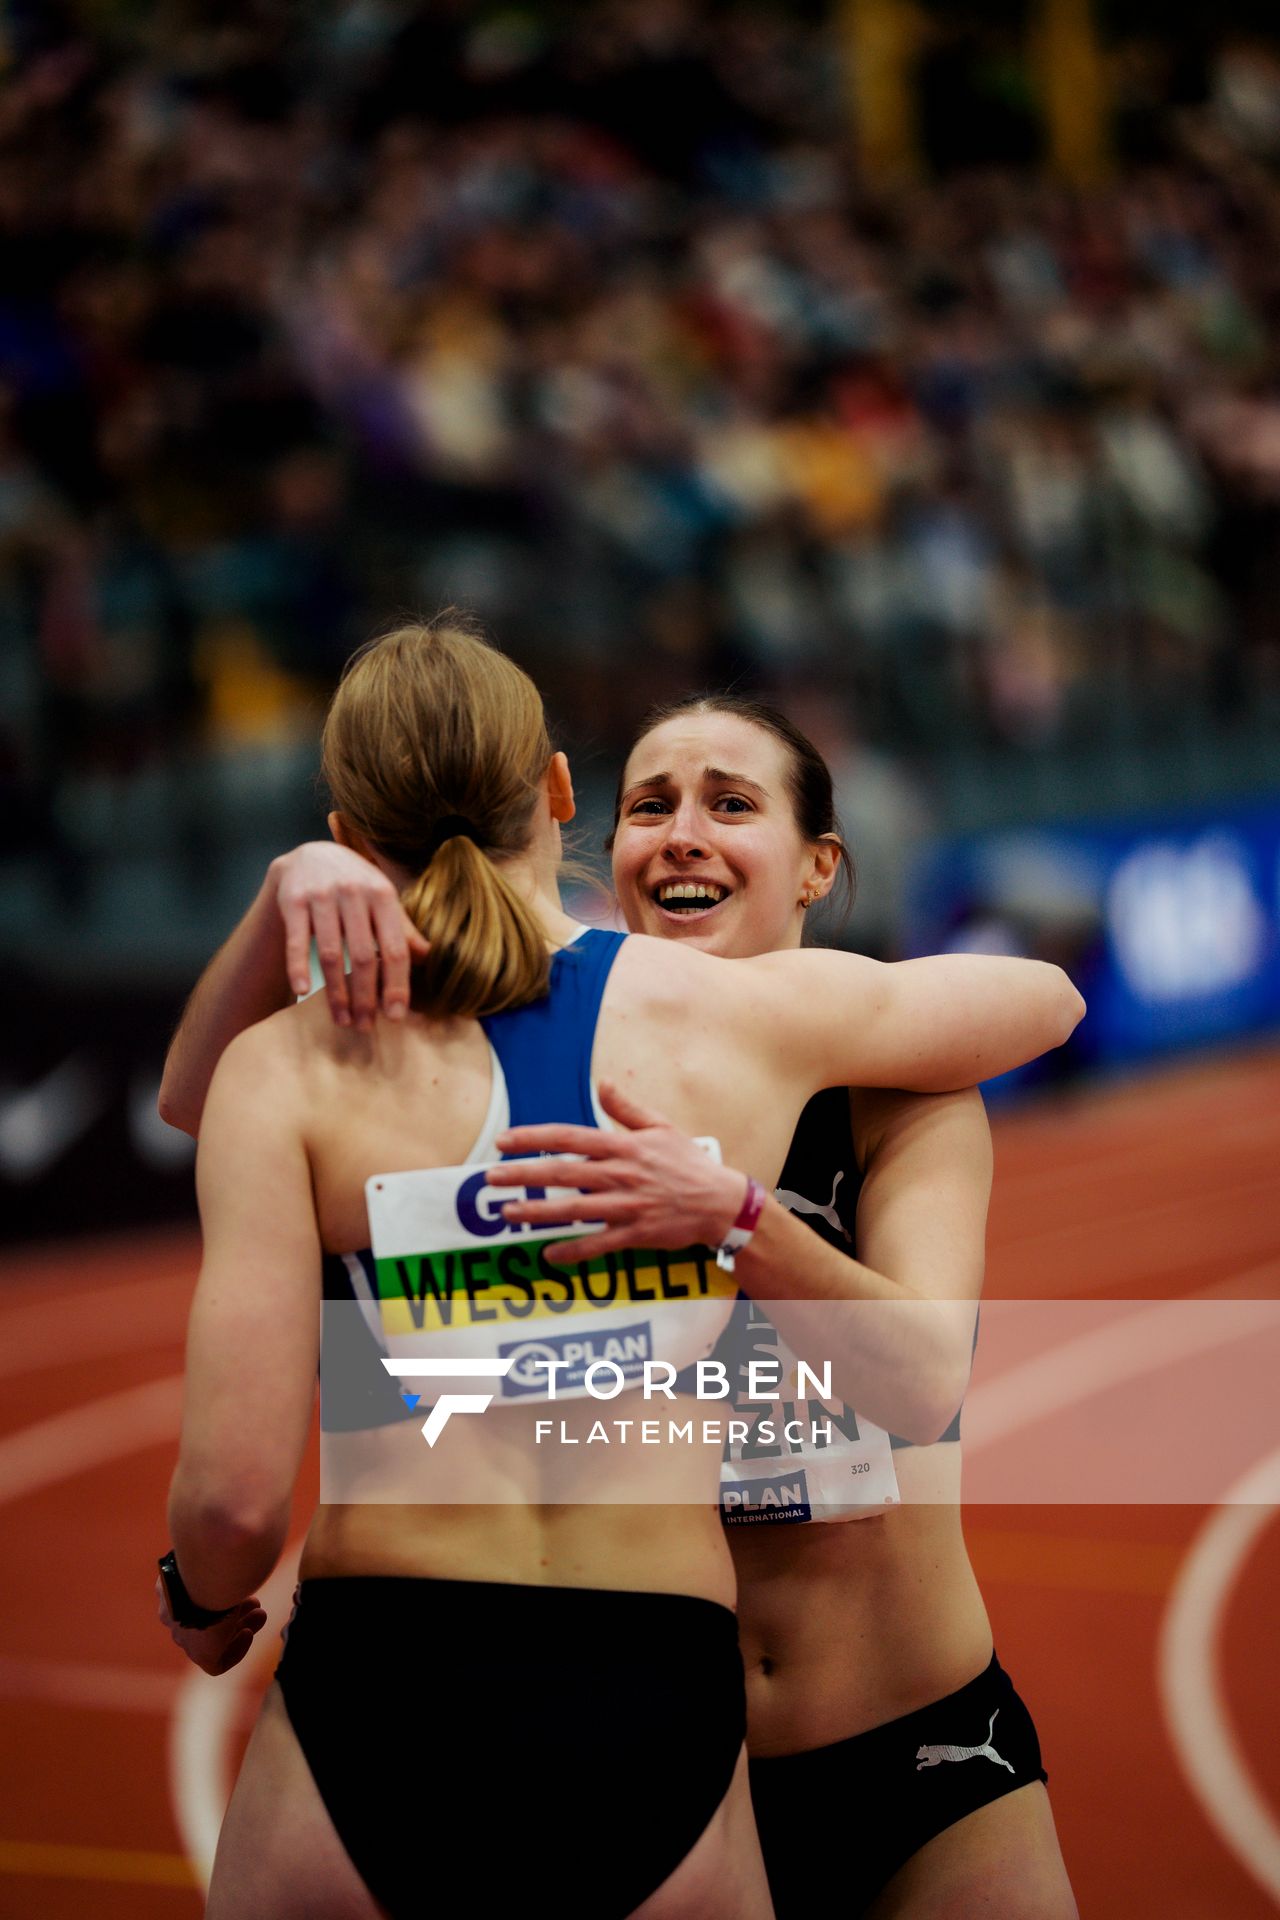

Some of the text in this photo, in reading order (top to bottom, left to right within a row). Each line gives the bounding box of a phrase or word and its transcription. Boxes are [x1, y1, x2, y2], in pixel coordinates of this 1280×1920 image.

[562, 1333, 648, 1369] PLAN
[722, 1399, 861, 1463] ZIN
[851, 1462, 870, 1475] 320
[723, 1483, 803, 1513] PLAN
[726, 1508, 805, 1524] INTERNATIONAL
